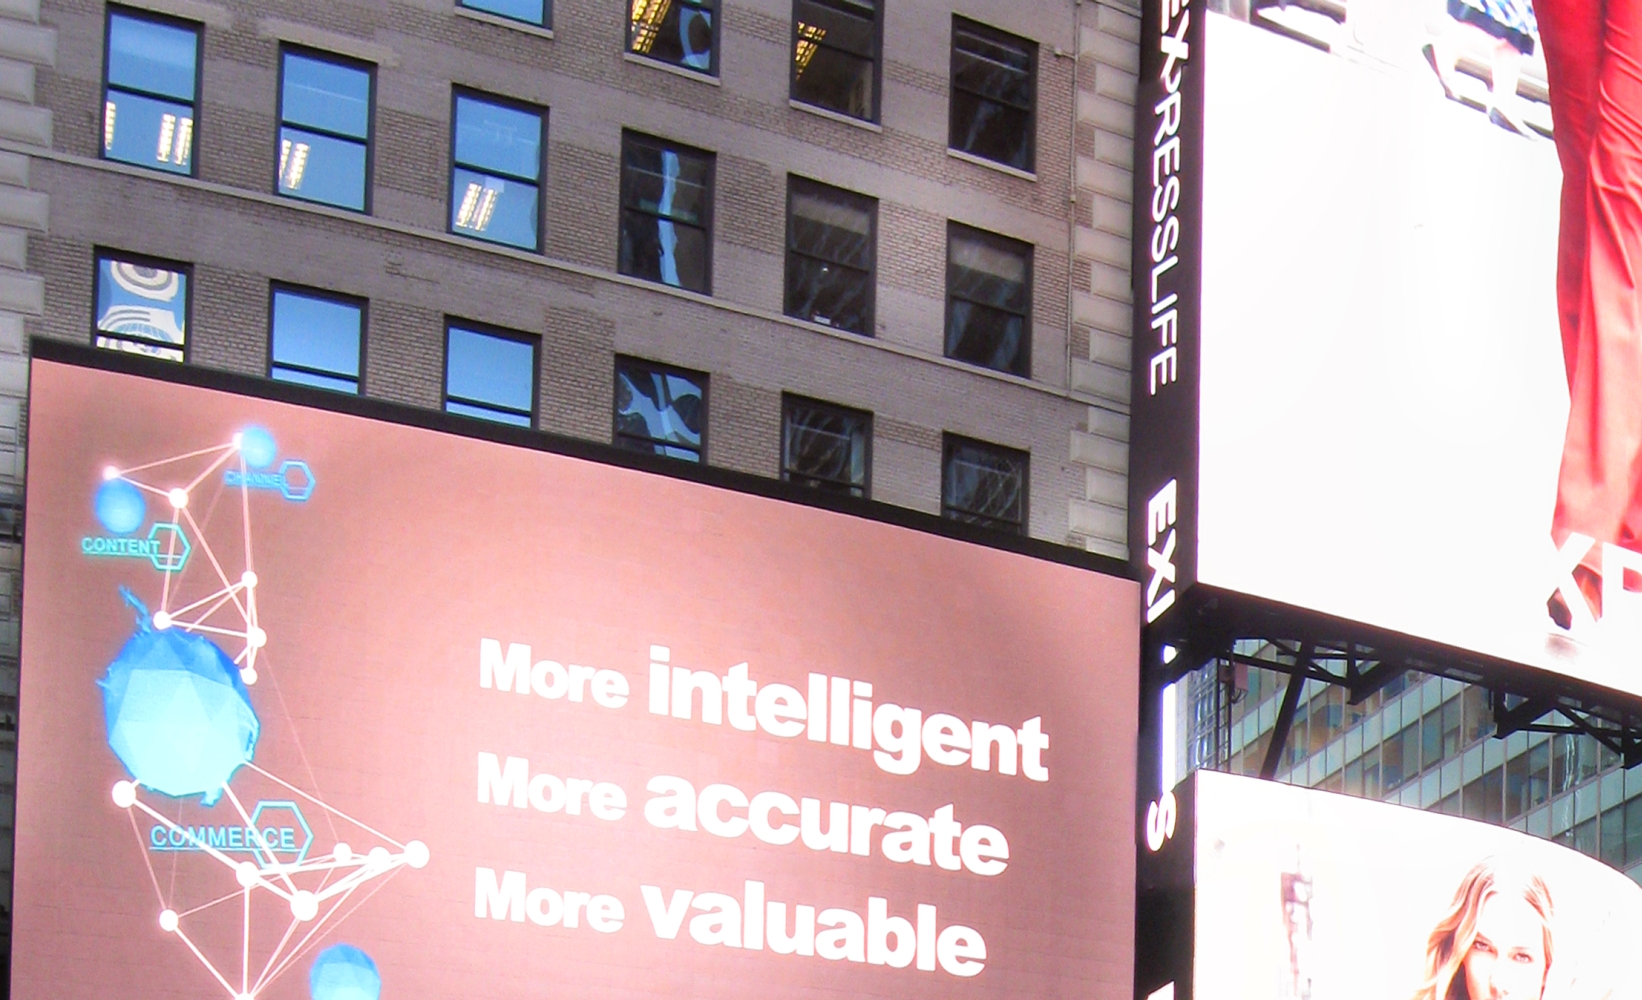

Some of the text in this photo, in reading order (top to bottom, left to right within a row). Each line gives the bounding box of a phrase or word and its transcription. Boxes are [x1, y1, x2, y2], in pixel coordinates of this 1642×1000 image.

[82, 536, 161, 555] CONTENT
[479, 637, 1049, 782] More intelligent
[150, 824, 296, 850] COMMERCE
[477, 751, 1009, 875] More accurate
[474, 866, 987, 977] More valuable
